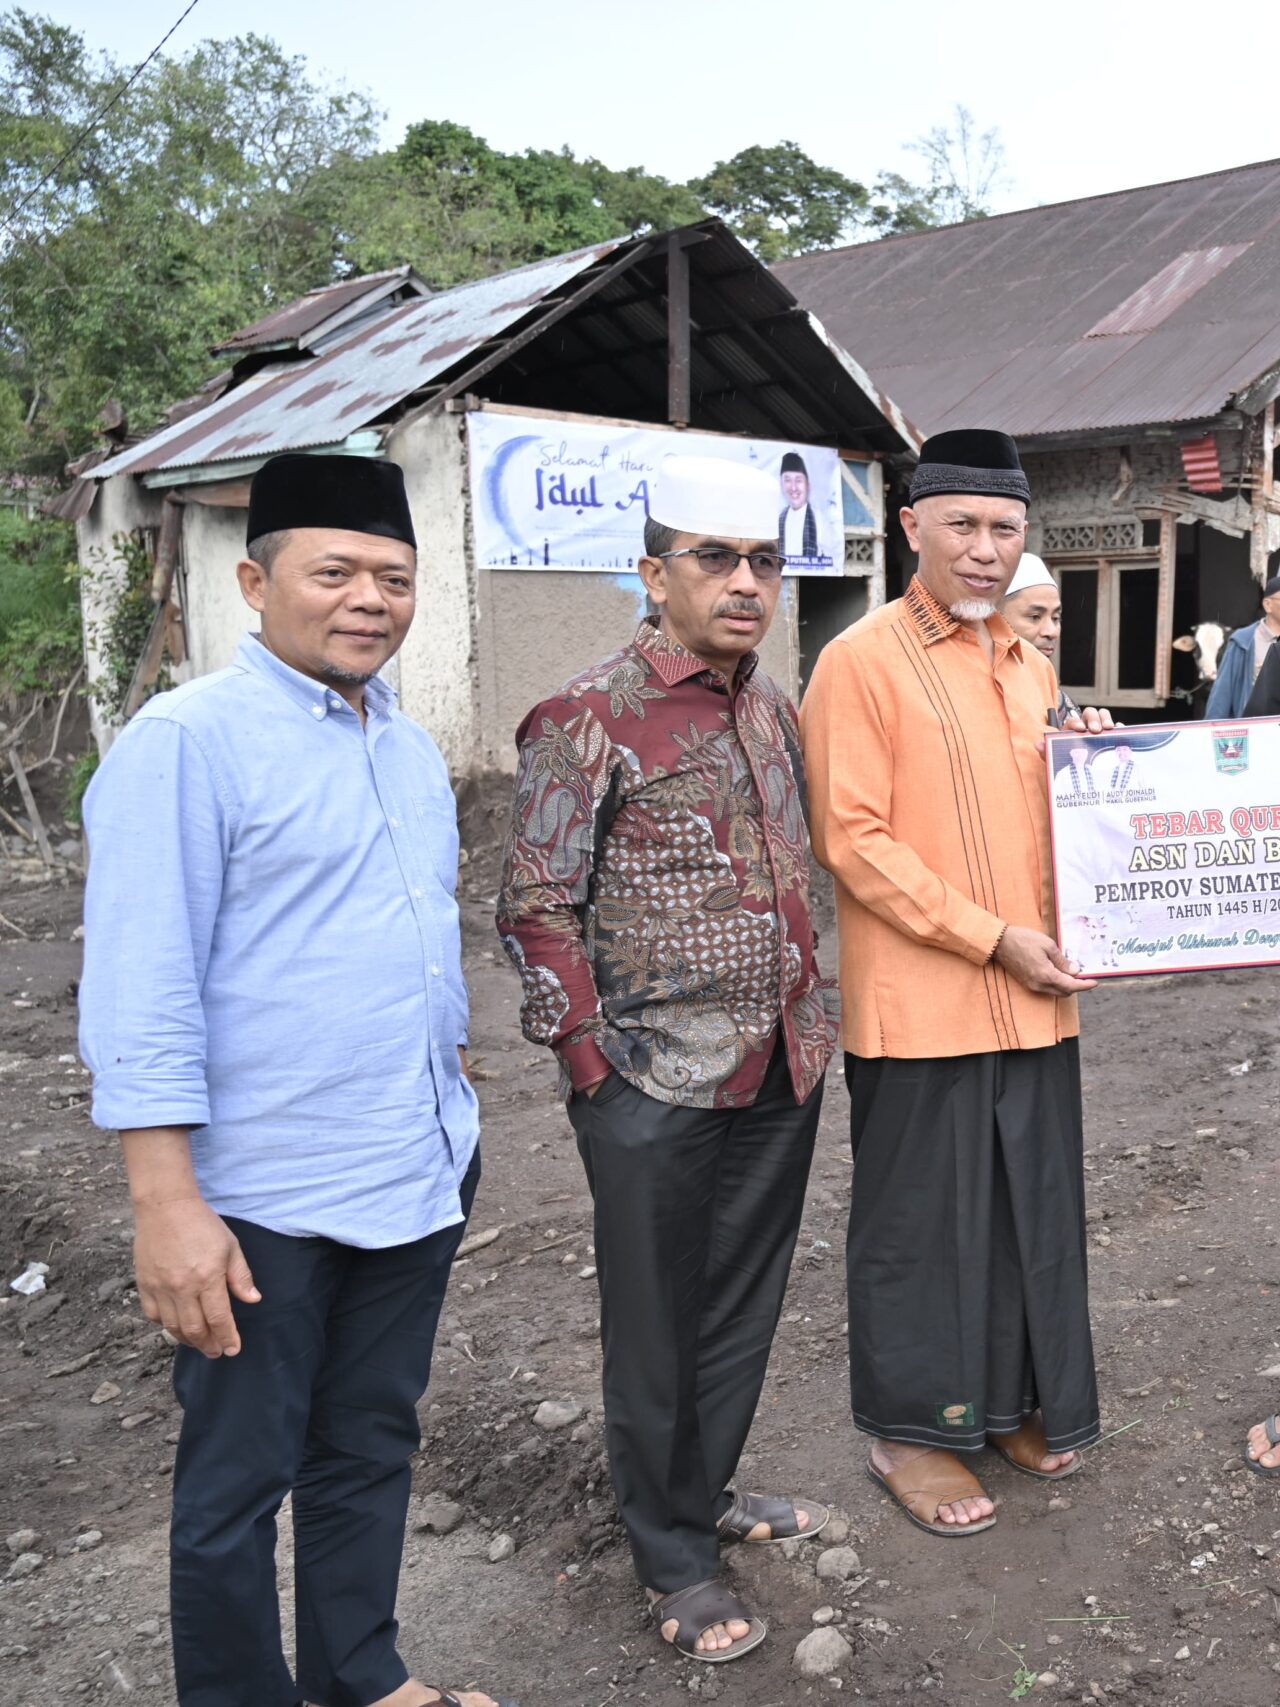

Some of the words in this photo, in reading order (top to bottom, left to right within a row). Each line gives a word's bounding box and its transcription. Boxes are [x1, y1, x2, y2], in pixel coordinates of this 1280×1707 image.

[540, 440, 610, 468] Selamat
[535, 467, 604, 515] Idul
[1056, 790, 1101, 802] MAHYELDI
[1056, 799, 1100, 808] GUBERNUR
[1106, 789, 1124, 798] AUDY
[1130, 808, 1225, 840] TEBAR
[1128, 843, 1186, 872] ASN
[1195, 839, 1255, 867] DAN
[1094, 878, 1193, 903] PEMPROV
[1166, 903, 1212, 920] TAHUN
[1217, 900, 1248, 916] 1445
